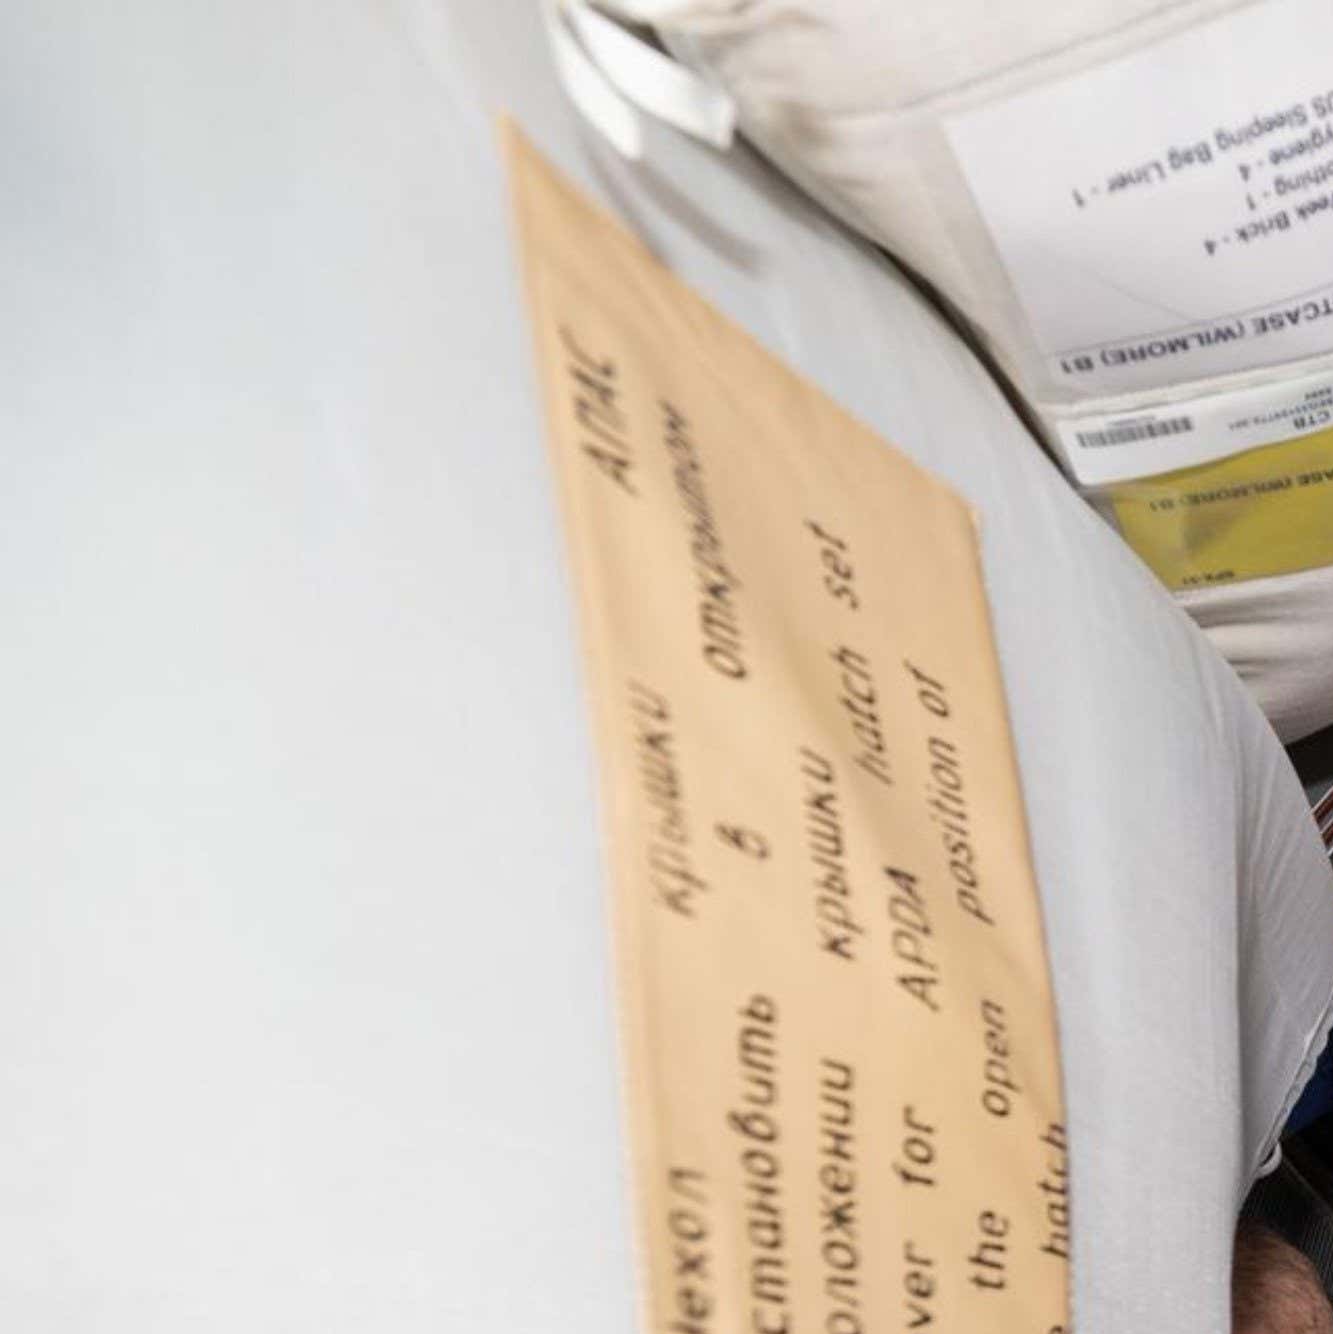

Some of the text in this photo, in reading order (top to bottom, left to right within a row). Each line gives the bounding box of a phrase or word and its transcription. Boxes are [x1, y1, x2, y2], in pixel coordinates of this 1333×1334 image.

[1166, 140, 1213, 172] Bag
[1213, 104, 1309, 152] Sleeping
[1106, 159, 1167, 194] Liner
[1237, 162, 1252, 182] 4
[1203, 239, 1218, 257] 4
[1234, 209, 1291, 244] Brick
[1100, 313, 1247, 368] (WILMORE)
[802, 517, 861, 611] set
[828, 644, 893, 787] hatch
[901, 658, 952, 719] of
[799, 744, 865, 962] крышки
[926, 735, 997, 928] position
[979, 997, 1023, 1119] open
[891, 1104, 938, 1189] for
[966, 1208, 1012, 1292] the
